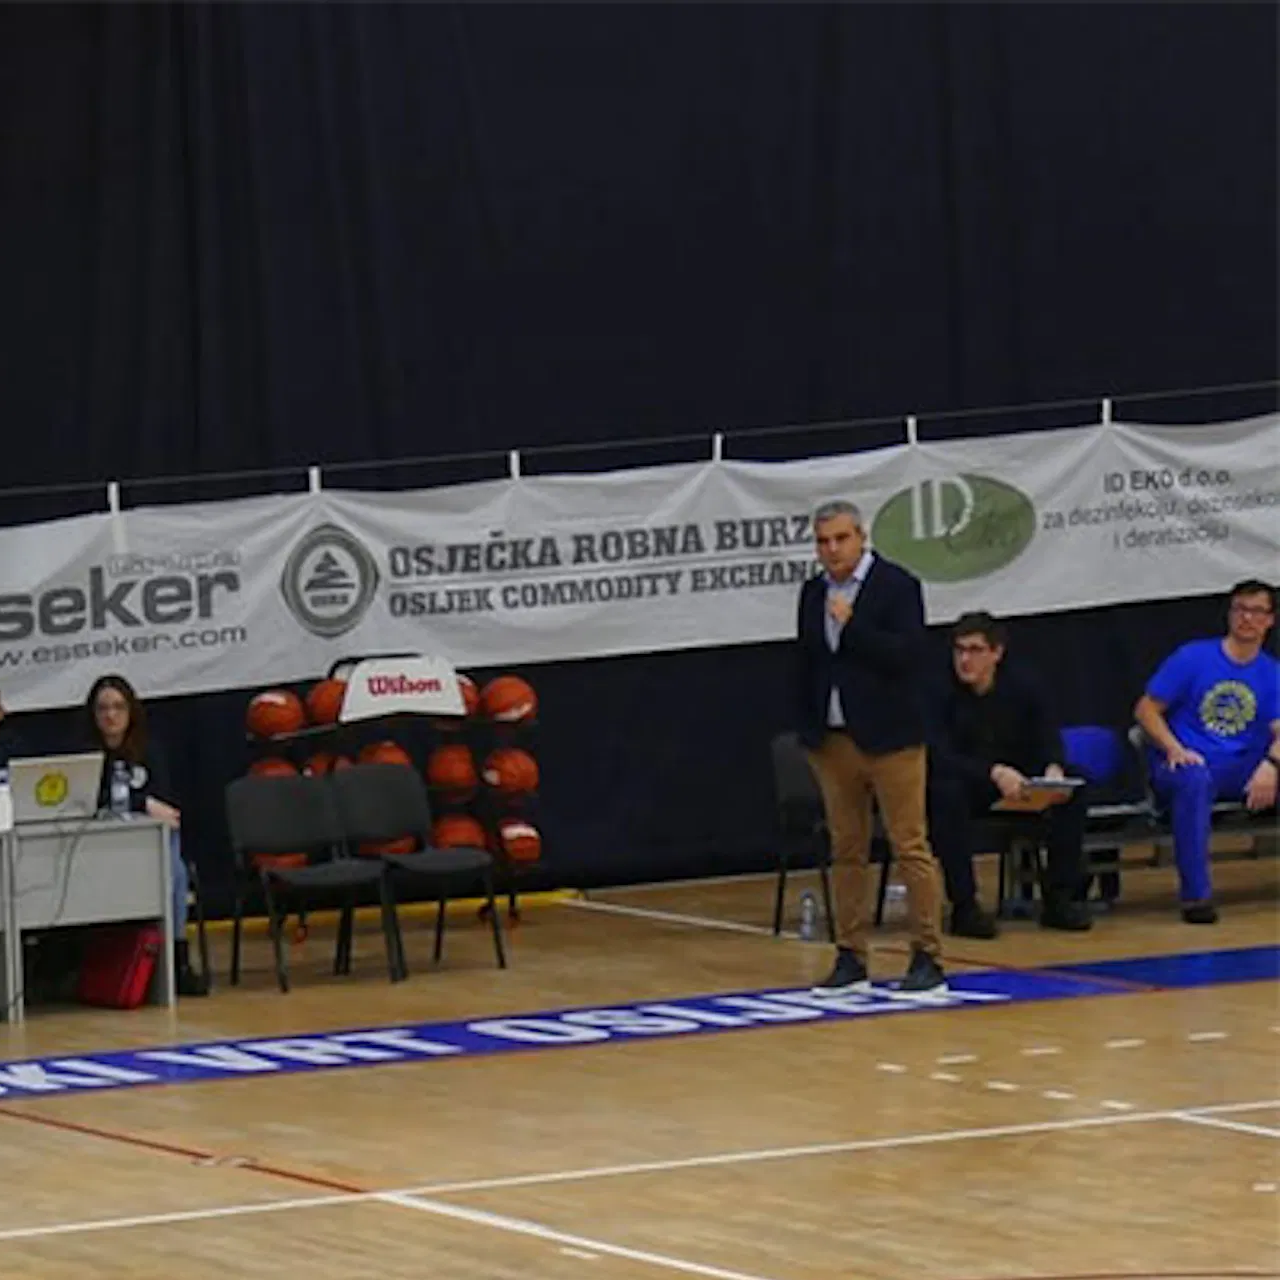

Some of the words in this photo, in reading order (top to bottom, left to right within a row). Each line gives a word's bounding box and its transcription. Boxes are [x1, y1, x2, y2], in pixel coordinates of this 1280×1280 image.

[1130, 470, 1174, 489] EKO
[389, 531, 560, 578] OSJEČKA
[572, 523, 704, 567] ROBNA
[715, 515, 809, 553] BURZ
[389, 587, 495, 617] OSIJEK
[502, 568, 681, 610] COMMODITY
[690, 559, 817, 593] EXCHAN
[367, 674, 441, 697] Wilson
[137, 1028, 464, 1071] VRT
